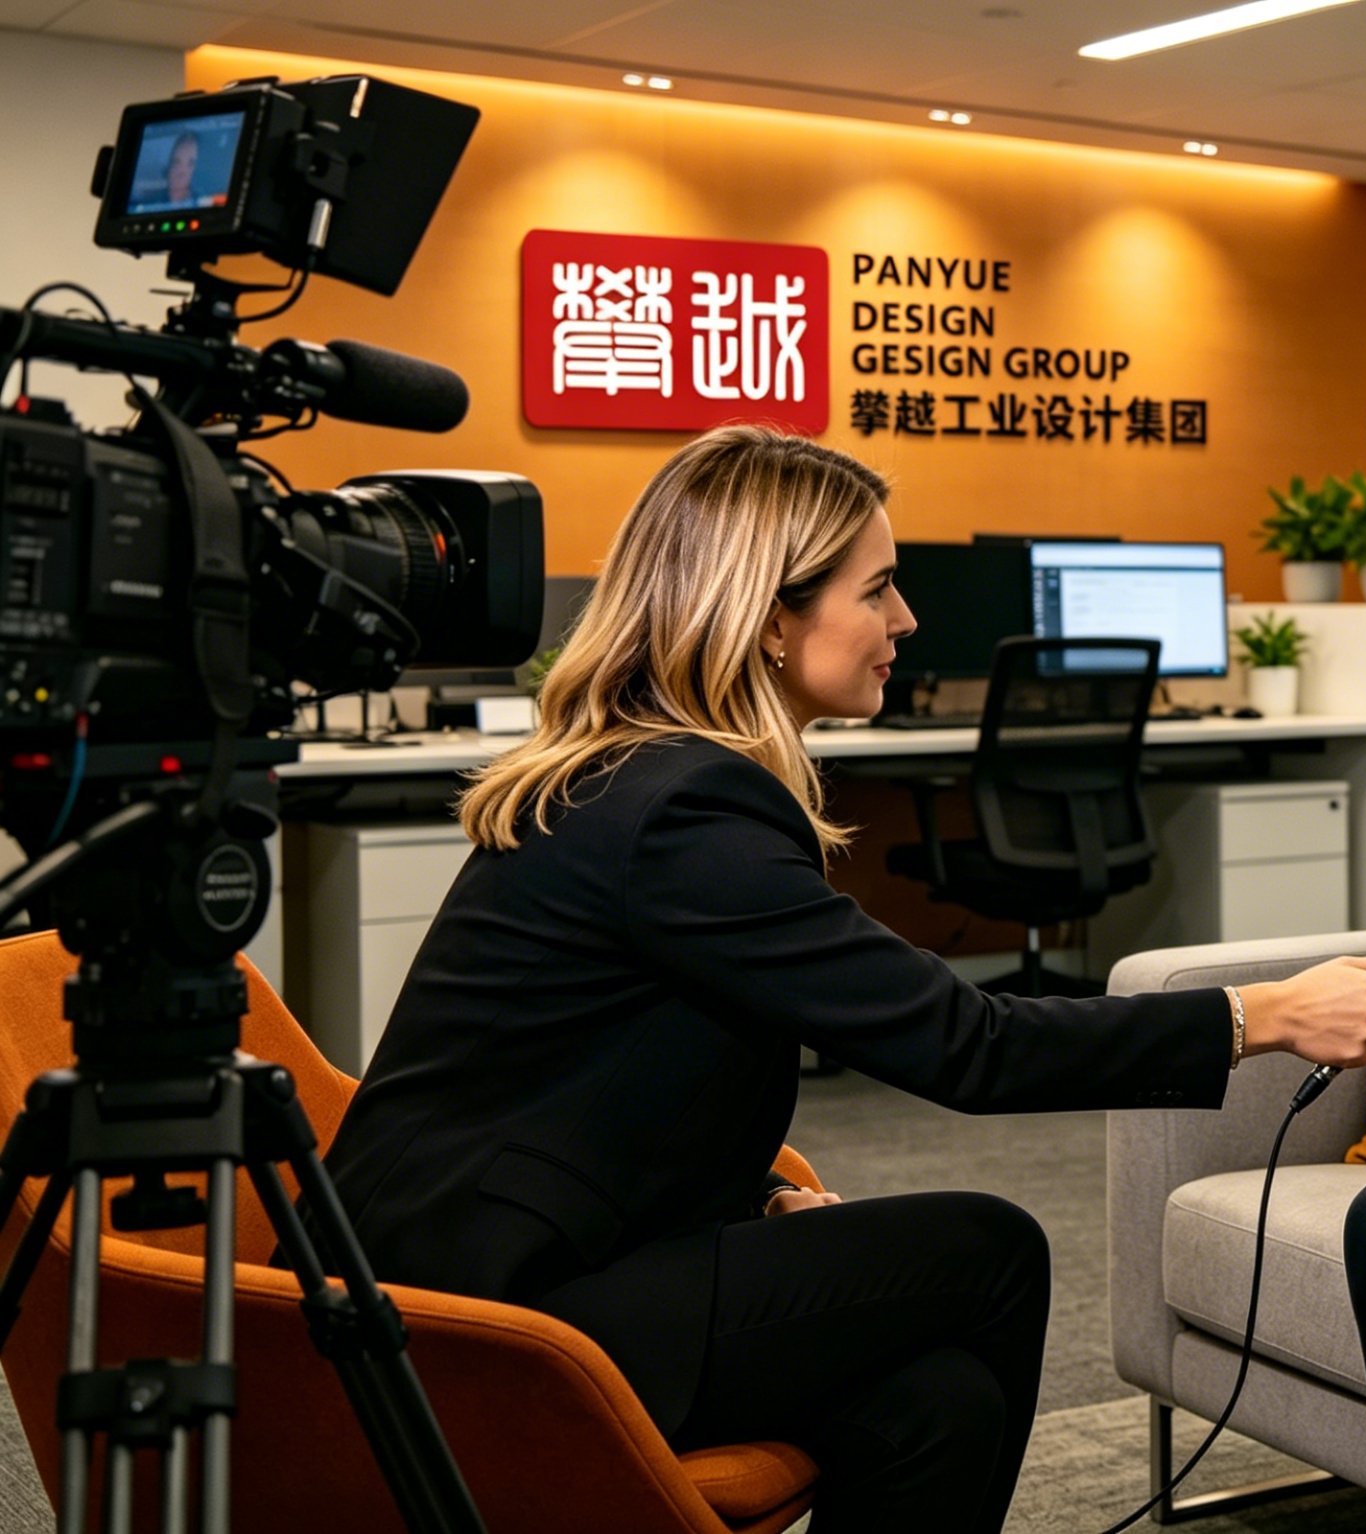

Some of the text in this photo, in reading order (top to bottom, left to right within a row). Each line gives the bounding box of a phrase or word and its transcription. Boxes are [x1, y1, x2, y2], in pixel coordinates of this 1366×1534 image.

[853, 253, 1012, 293] PANYUE
[852, 301, 995, 337] DESIGN
[852, 343, 1131, 383] GESIGN GROUP
[850, 390, 1208, 445] 攀越工业设计集团
